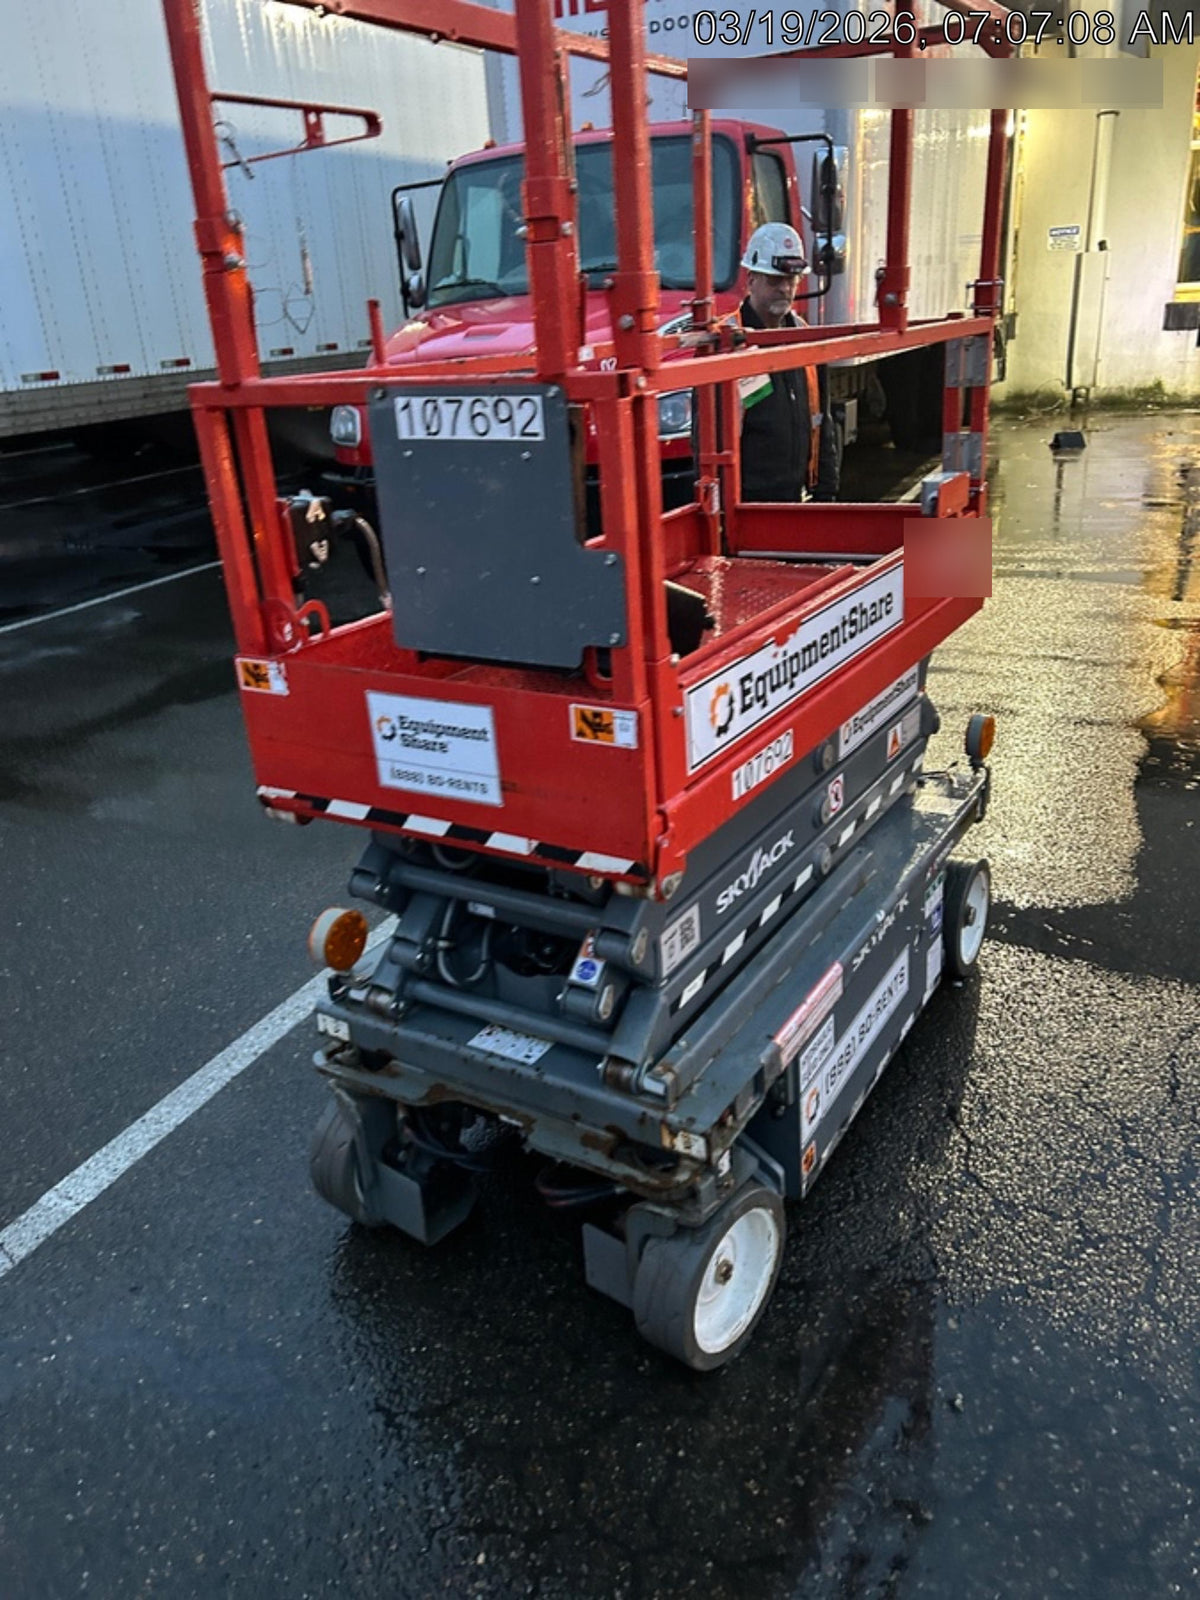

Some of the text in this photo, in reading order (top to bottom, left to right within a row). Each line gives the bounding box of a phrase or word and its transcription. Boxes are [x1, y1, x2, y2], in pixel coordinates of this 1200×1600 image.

[399, 397, 541, 437] 107692
[738, 591, 895, 714] EquipmentShare
[398, 714, 490, 742] Equipment
[400, 732, 449, 754] Share
[733, 731, 792, 796] 107692
[715, 829, 796, 915] SKYJACK
